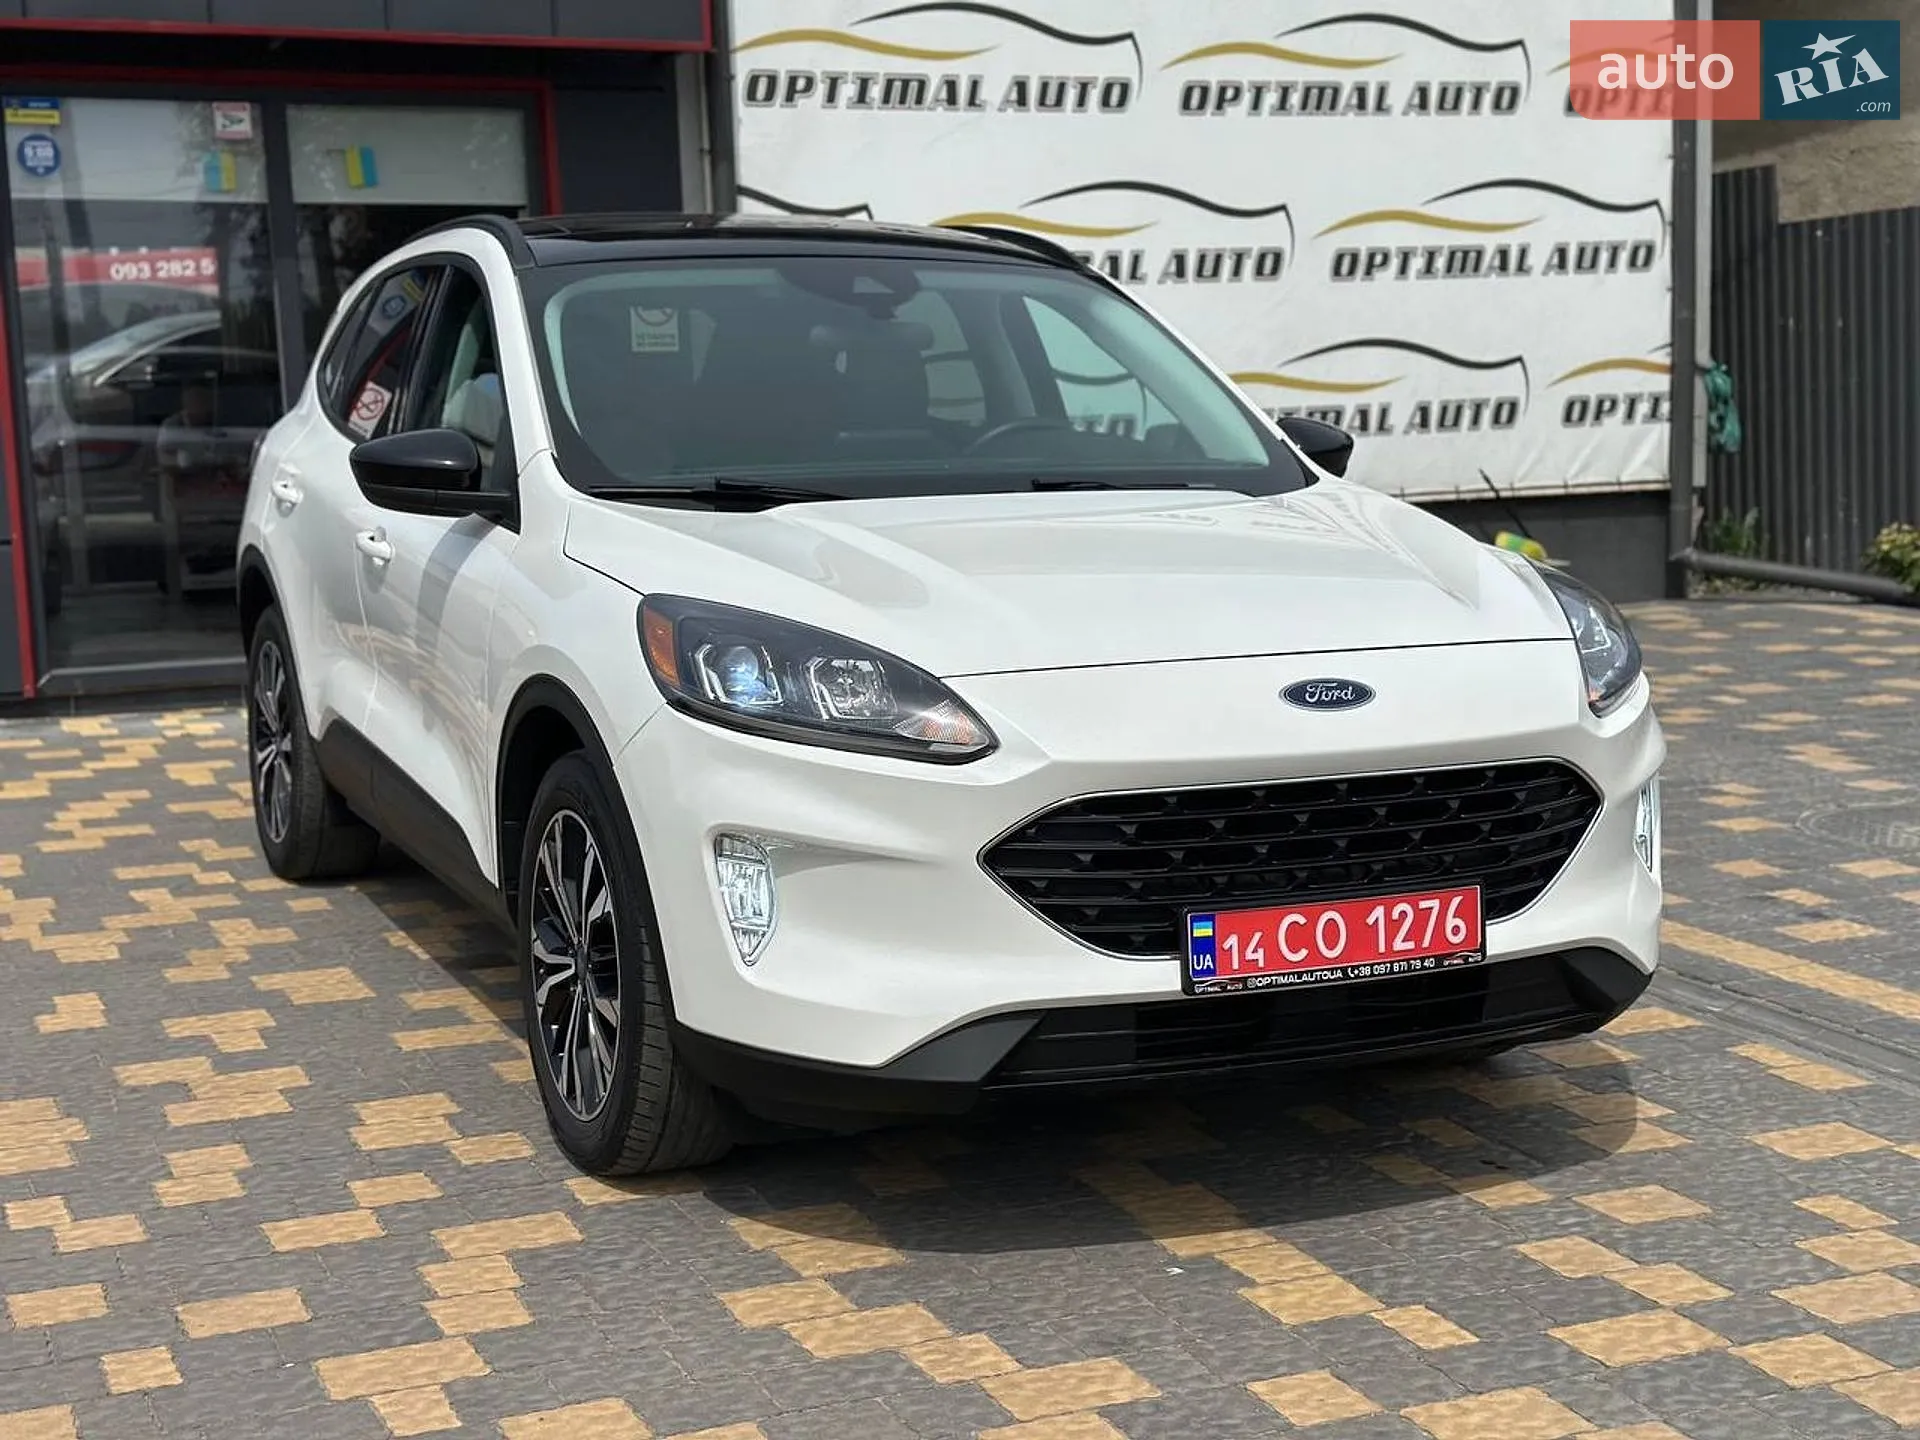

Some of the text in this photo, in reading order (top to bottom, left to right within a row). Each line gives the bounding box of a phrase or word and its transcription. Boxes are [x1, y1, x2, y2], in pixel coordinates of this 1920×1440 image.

[743, 68, 1133, 113] OPTIMAL AUTO
[1178, 80, 1522, 117] OPTIMAL AUTO
[109, 262, 151, 281] 093
[156, 259, 196, 278] 282
[1157, 246, 1286, 285] AUTO
[1329, 239, 1658, 283] OPTIMAL AUTO
[1403, 396, 1519, 434] AUTO
[1561, 391, 1670, 428] OPTI
[1305, 682, 1355, 703] Ford
[1222, 895, 1467, 970] 14 CO 1276
[1193, 954, 1214, 970] UA
